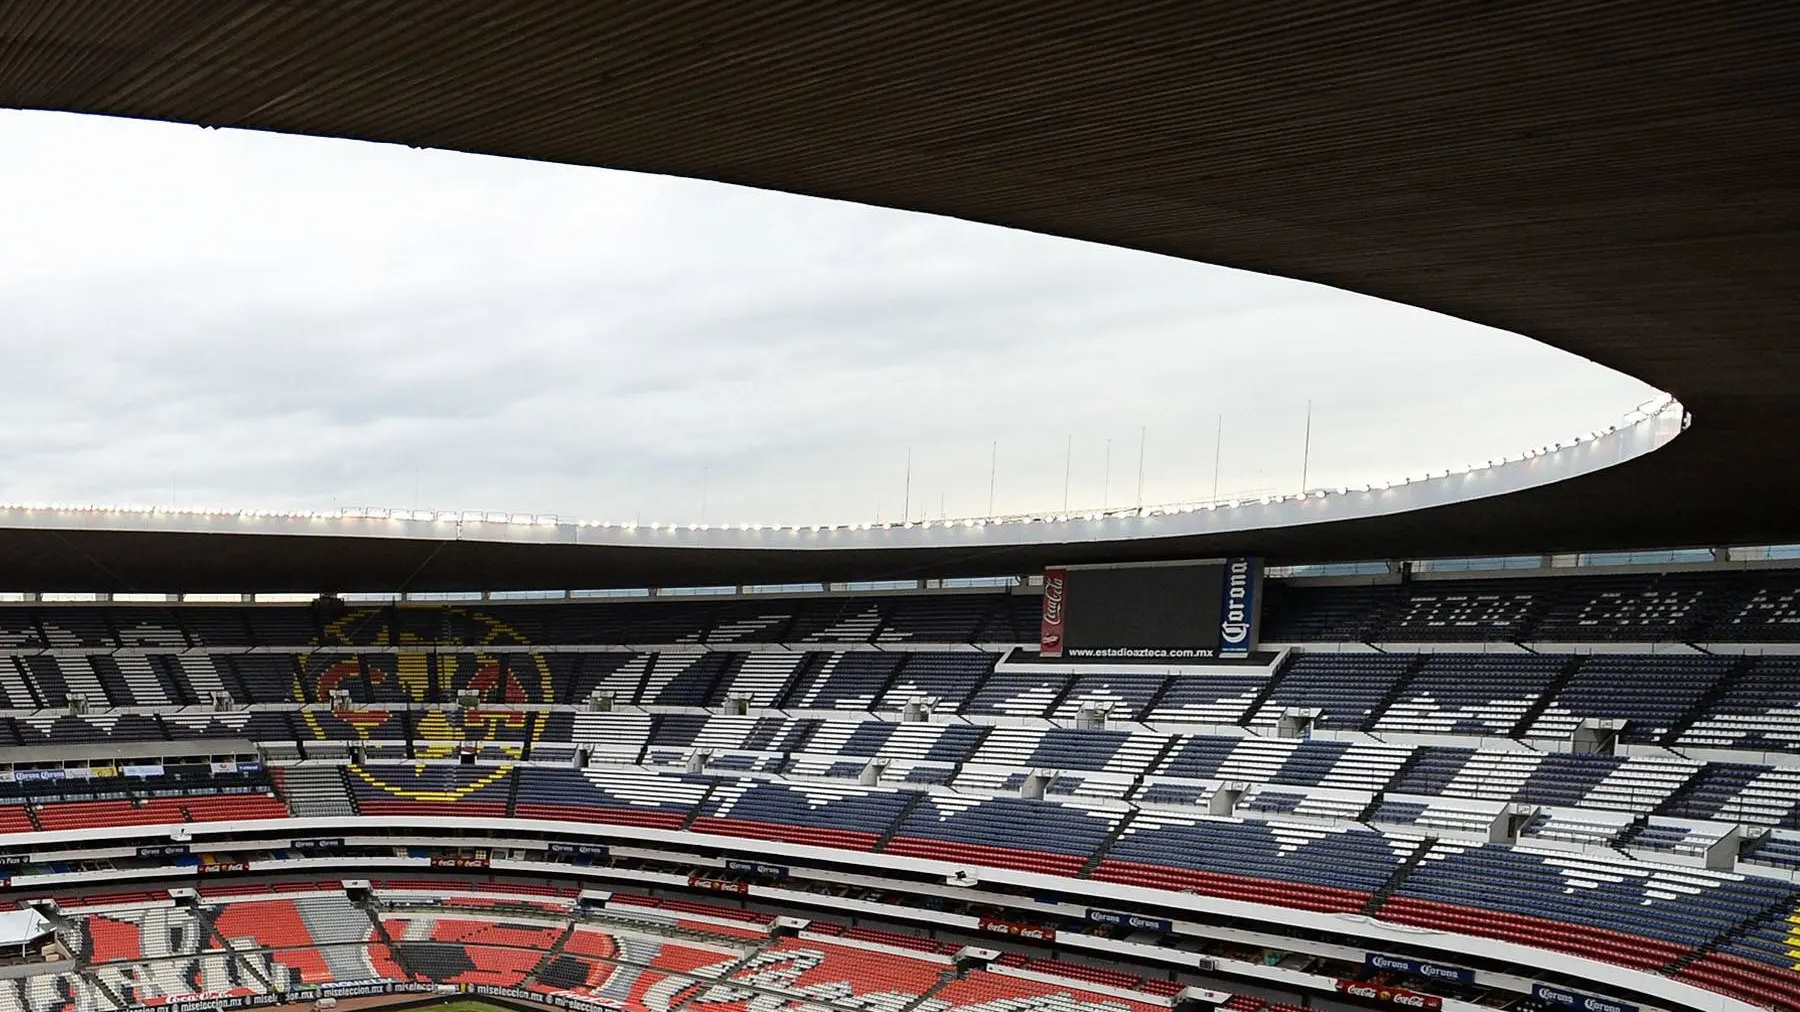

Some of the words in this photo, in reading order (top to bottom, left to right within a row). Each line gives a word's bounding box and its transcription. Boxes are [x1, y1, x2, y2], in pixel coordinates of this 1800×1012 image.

[1222, 561, 1250, 643] Corona
[1069, 647, 1214, 658] www.estadioazteca.com.mx
[1372, 955, 1409, 971] Corona
[1420, 964, 1459, 979] Corona
[477, 984, 544, 1002] miseleccion.mx
[1538, 987, 1574, 1005] Corona
